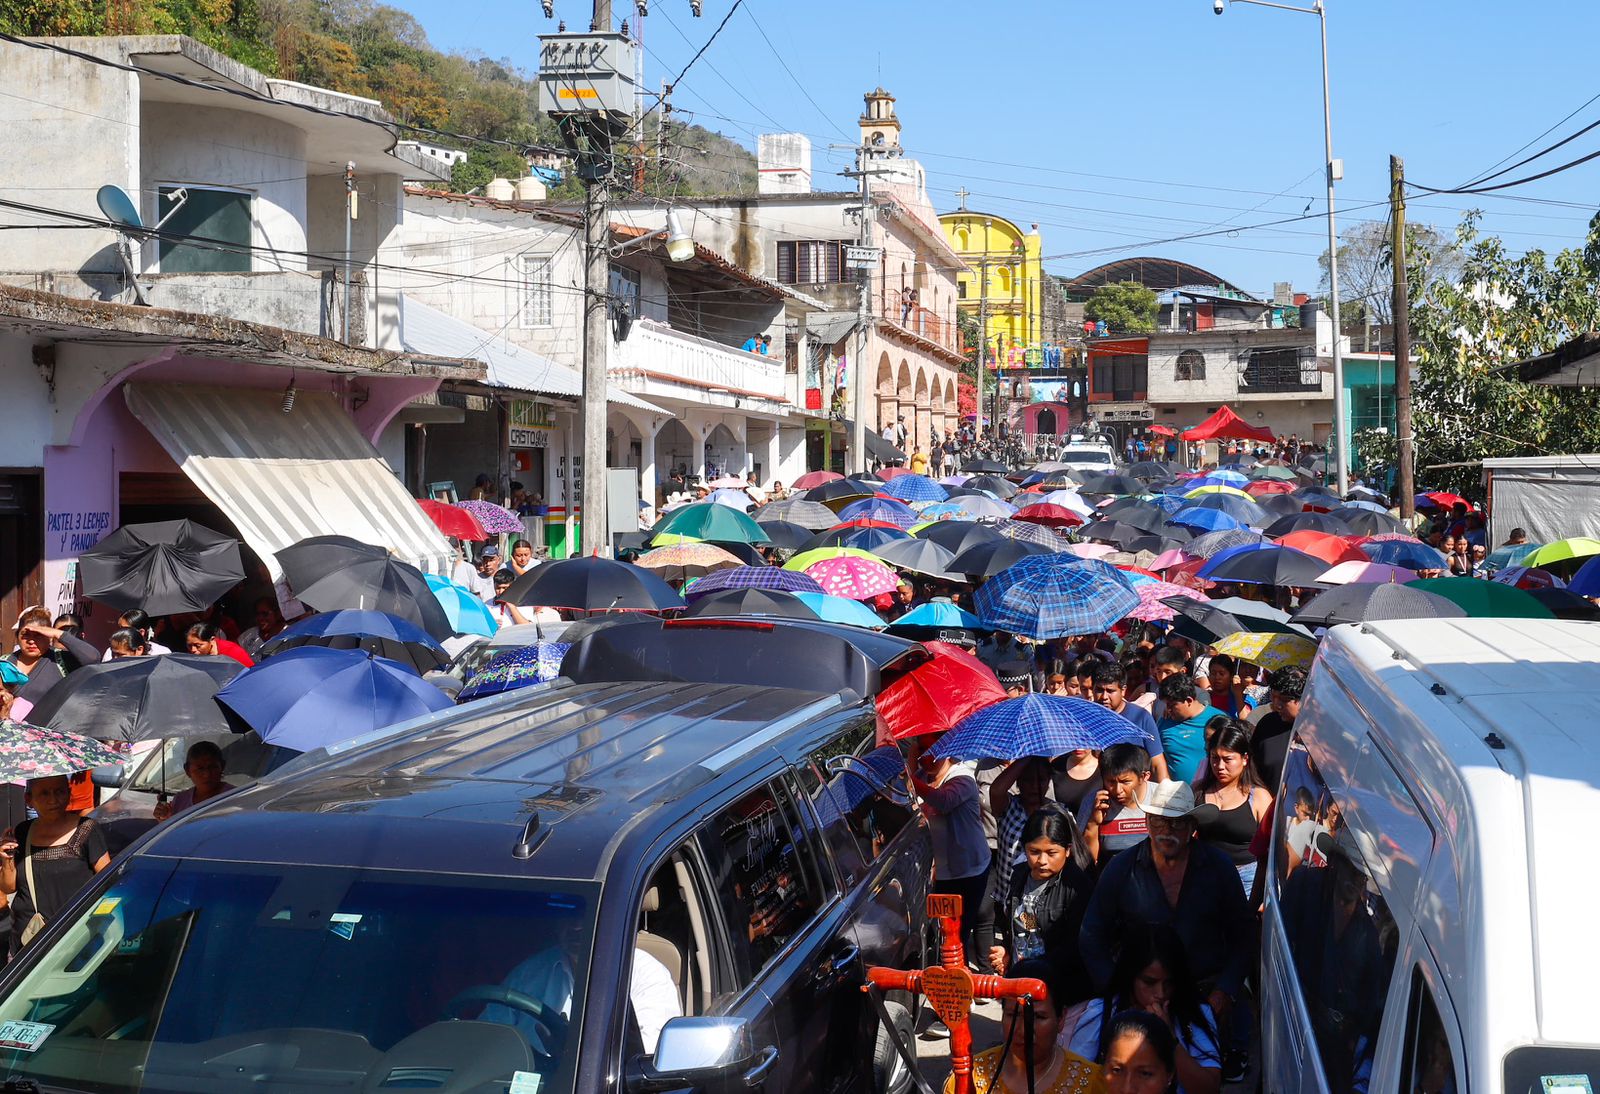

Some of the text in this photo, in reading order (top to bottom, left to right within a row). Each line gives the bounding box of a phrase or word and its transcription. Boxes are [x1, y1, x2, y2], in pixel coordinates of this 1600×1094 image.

[47, 511, 110, 532] PASTEL 3 LECHES
[60, 533, 67, 552] Y
[58, 580, 76, 601] PIÑA
[751, 857, 790, 896] FUNERALES
[928, 896, 955, 915] INRI
